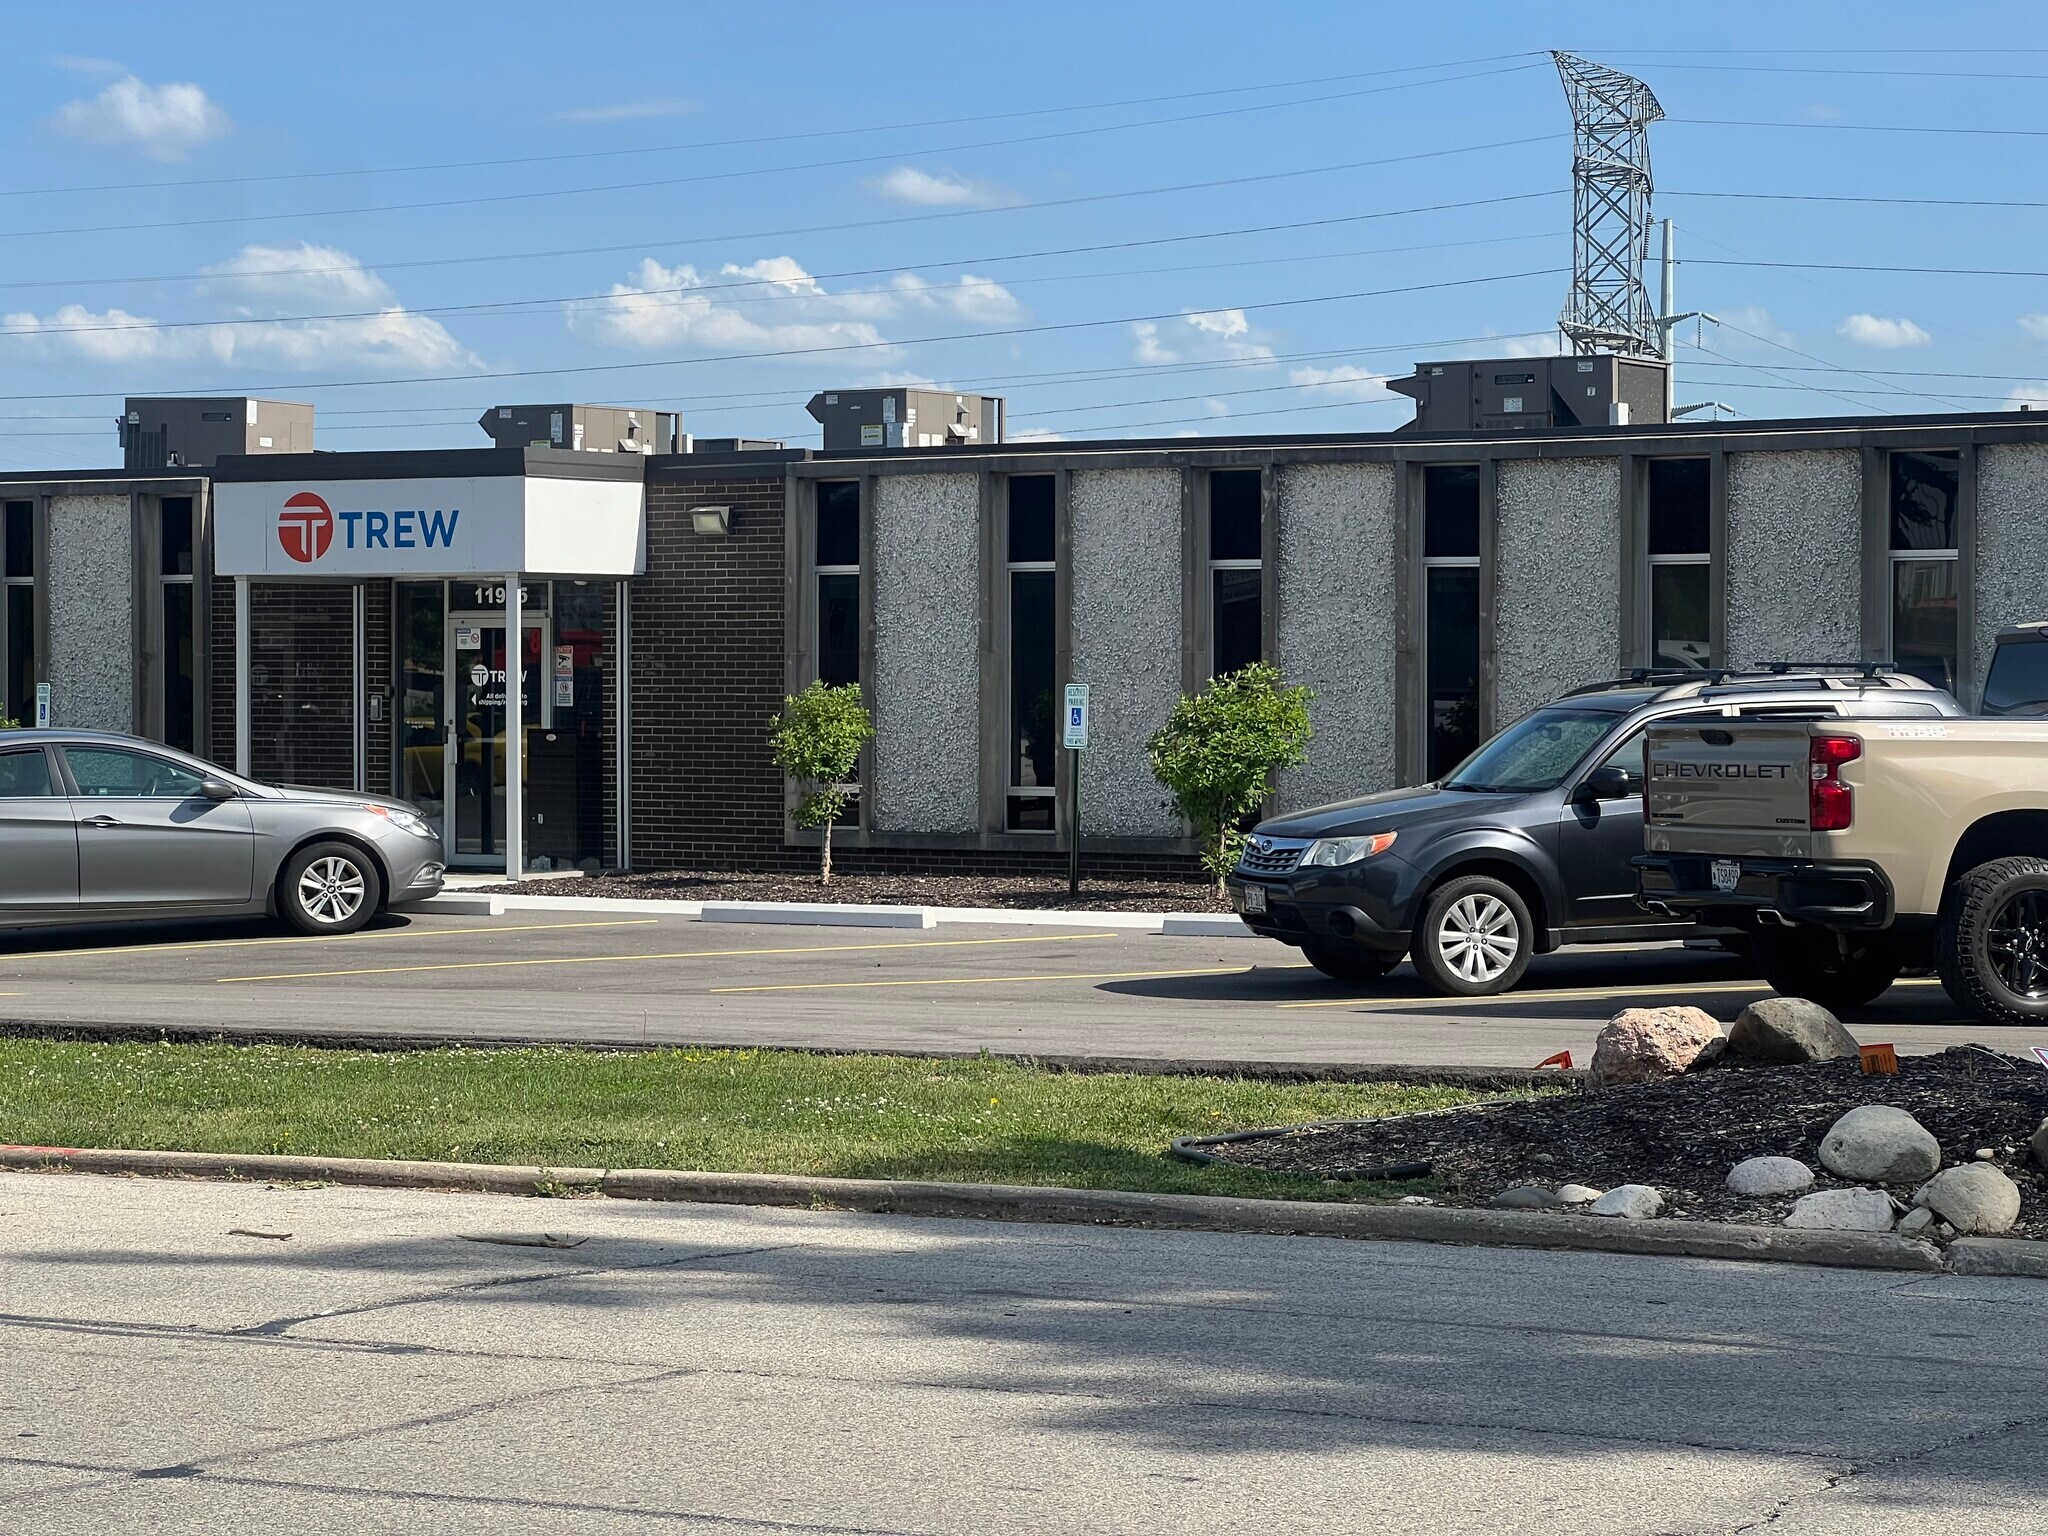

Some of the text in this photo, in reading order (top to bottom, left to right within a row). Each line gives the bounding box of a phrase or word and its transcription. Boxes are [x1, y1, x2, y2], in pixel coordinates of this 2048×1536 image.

[339, 510, 459, 548] TREW
[475, 587, 529, 604] 1195
[489, 670, 528, 682] TRW
[1068, 698, 1085, 706] PARKING
[1653, 763, 1791, 779] CHEVROLET
